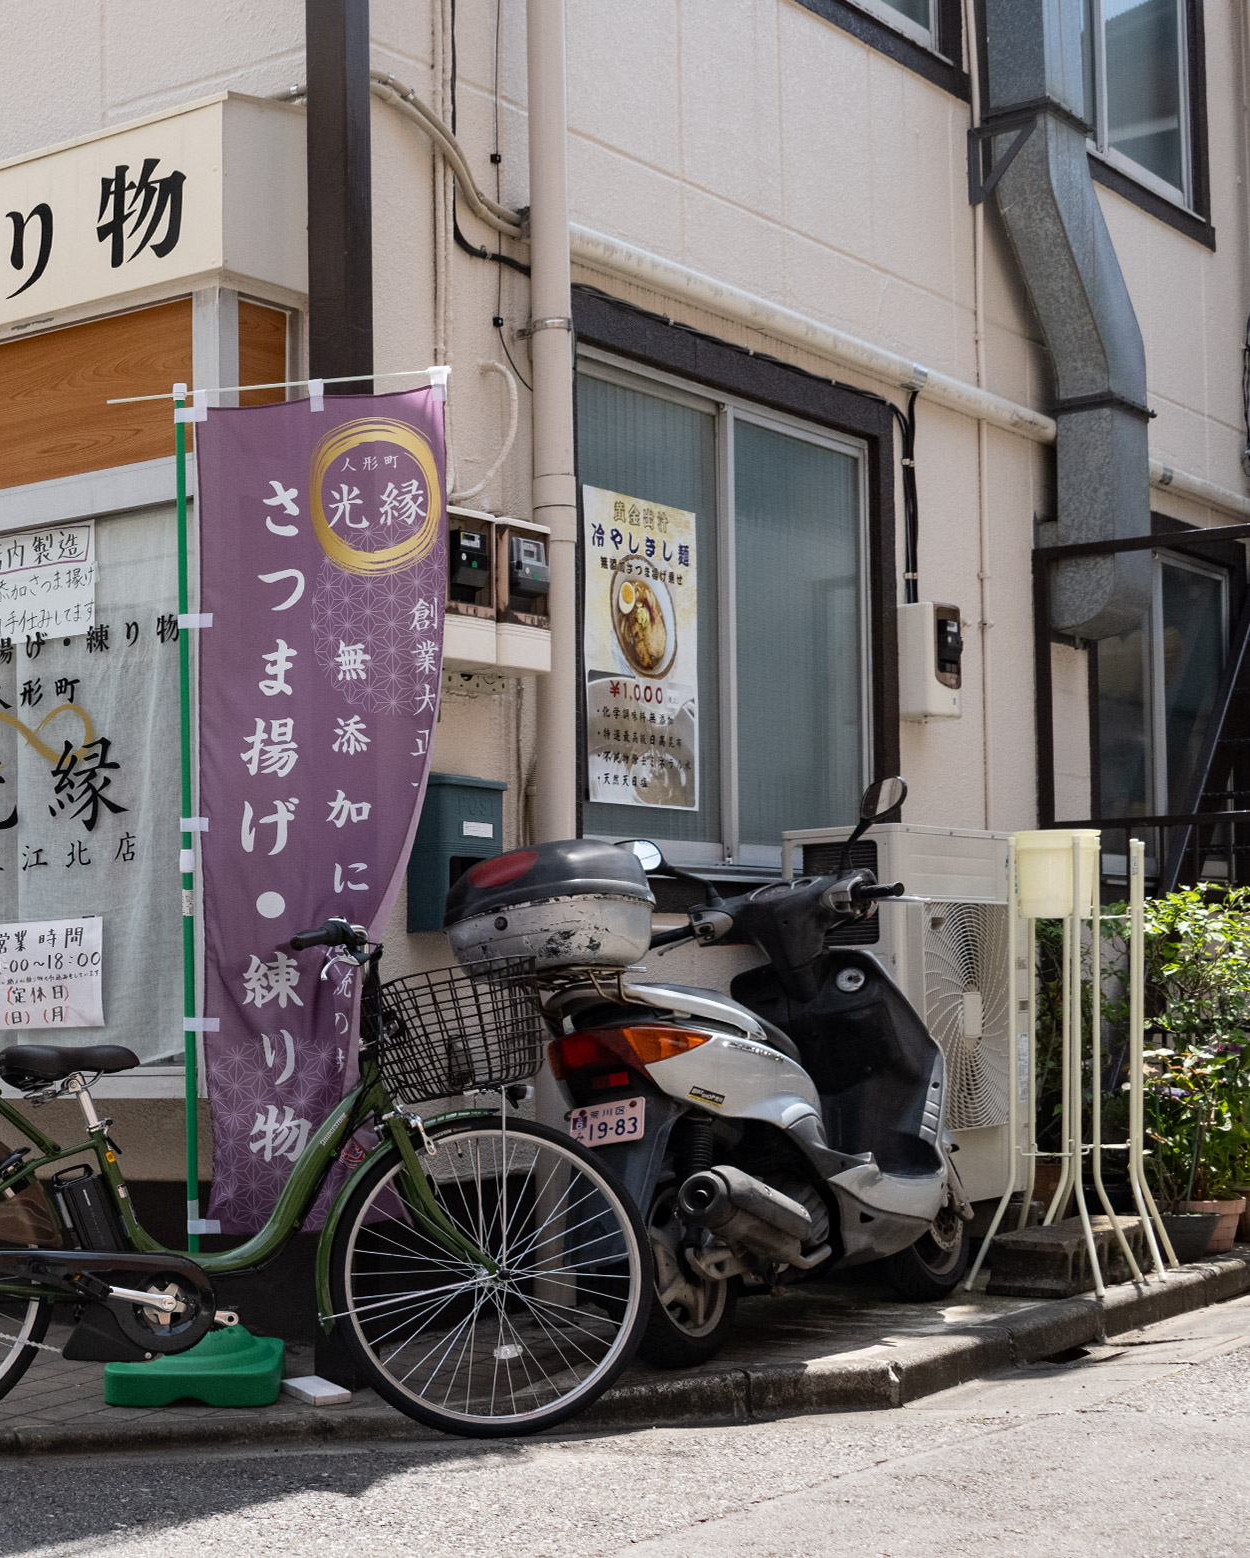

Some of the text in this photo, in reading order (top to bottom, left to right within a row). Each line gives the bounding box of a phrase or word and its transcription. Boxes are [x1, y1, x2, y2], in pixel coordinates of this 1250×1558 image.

[340, 455, 399, 472] 人形町
[328, 479, 427, 529] 光縁
[409, 597, 439, 787] 創業大正
[609, 680, 663, 704] ¥1,000
[240, 480, 312, 1162] さつま揚げ・練り物
[588, 1117, 639, 1141] 19-83
